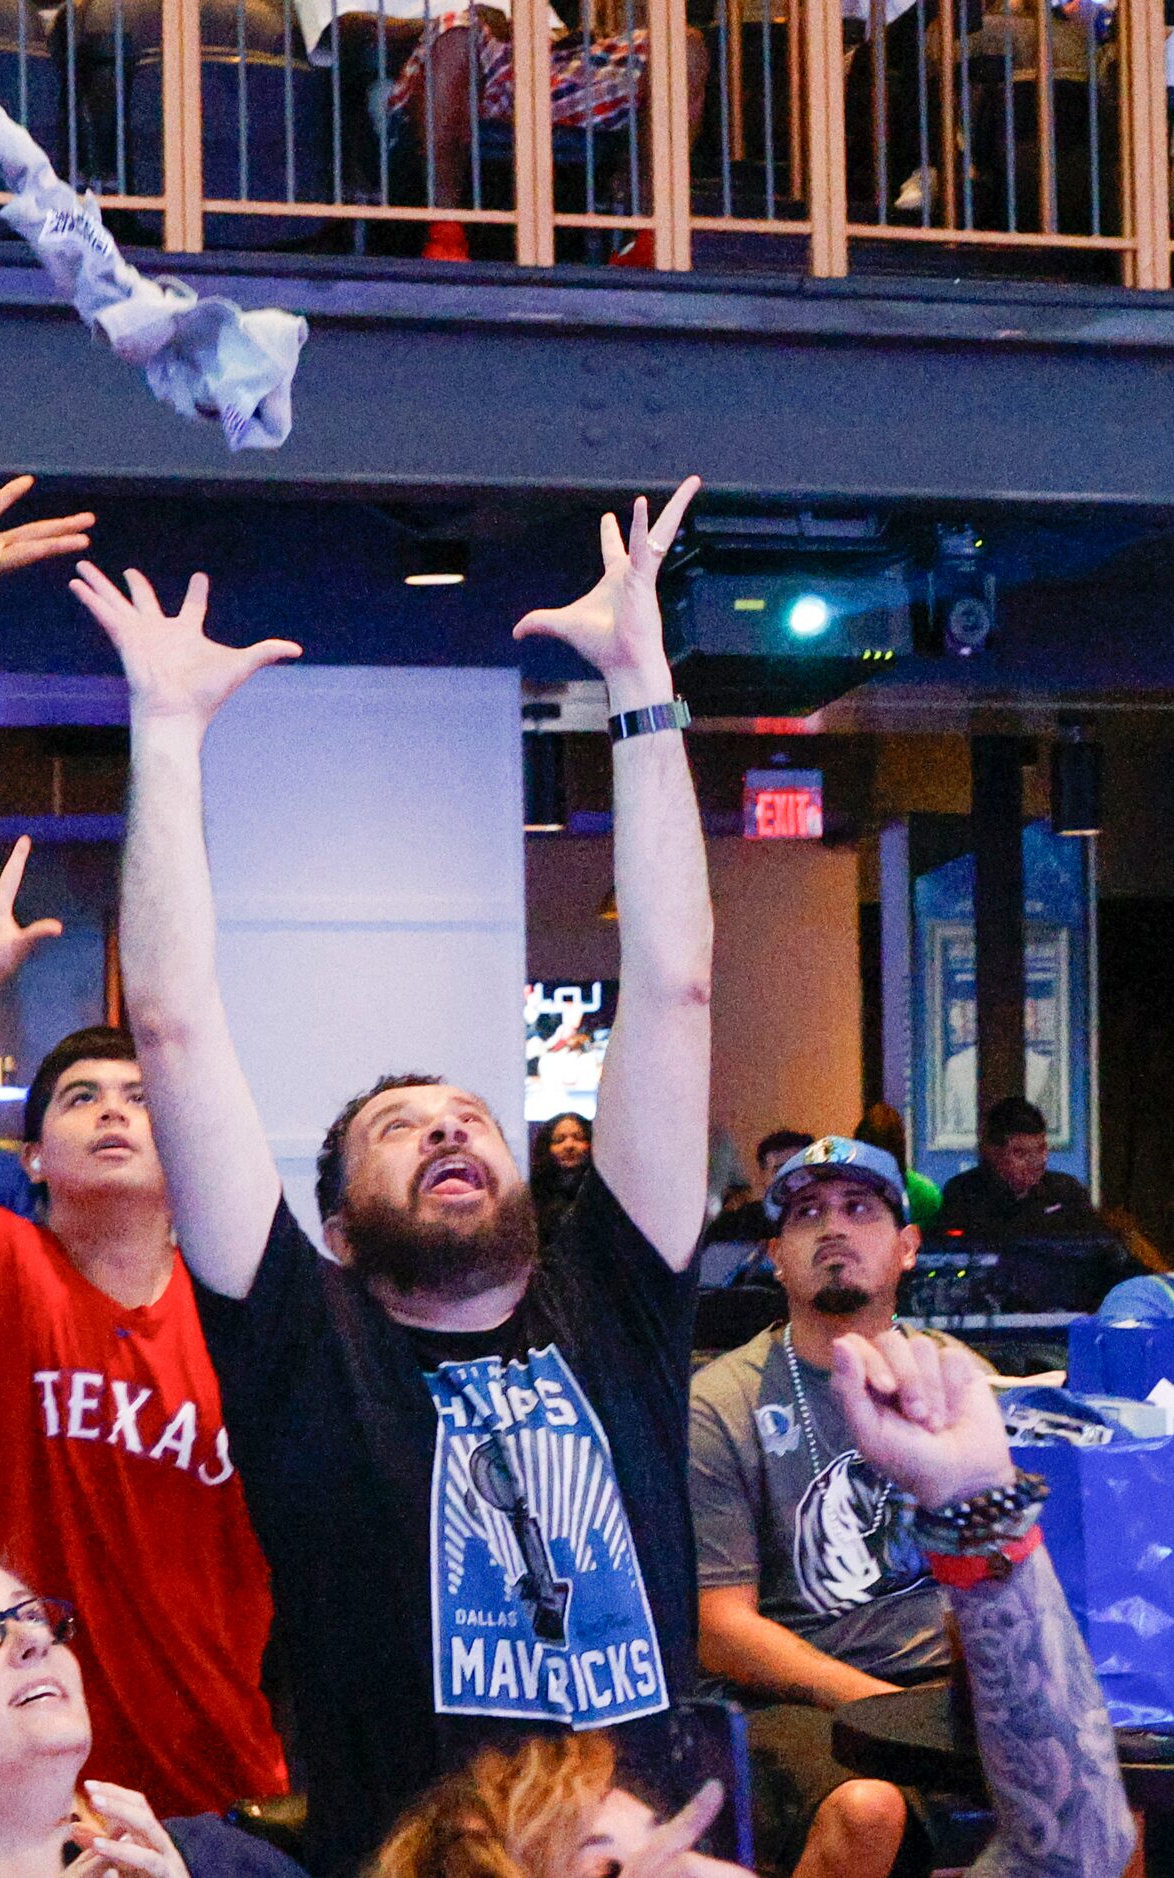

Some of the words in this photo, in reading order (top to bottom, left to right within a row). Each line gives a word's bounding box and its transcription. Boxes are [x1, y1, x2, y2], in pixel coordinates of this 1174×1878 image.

[756, 792, 810, 836] EXIT
[455, 1608, 518, 1628] DALLAS
[451, 1636, 657, 1715] MAVRICKS
